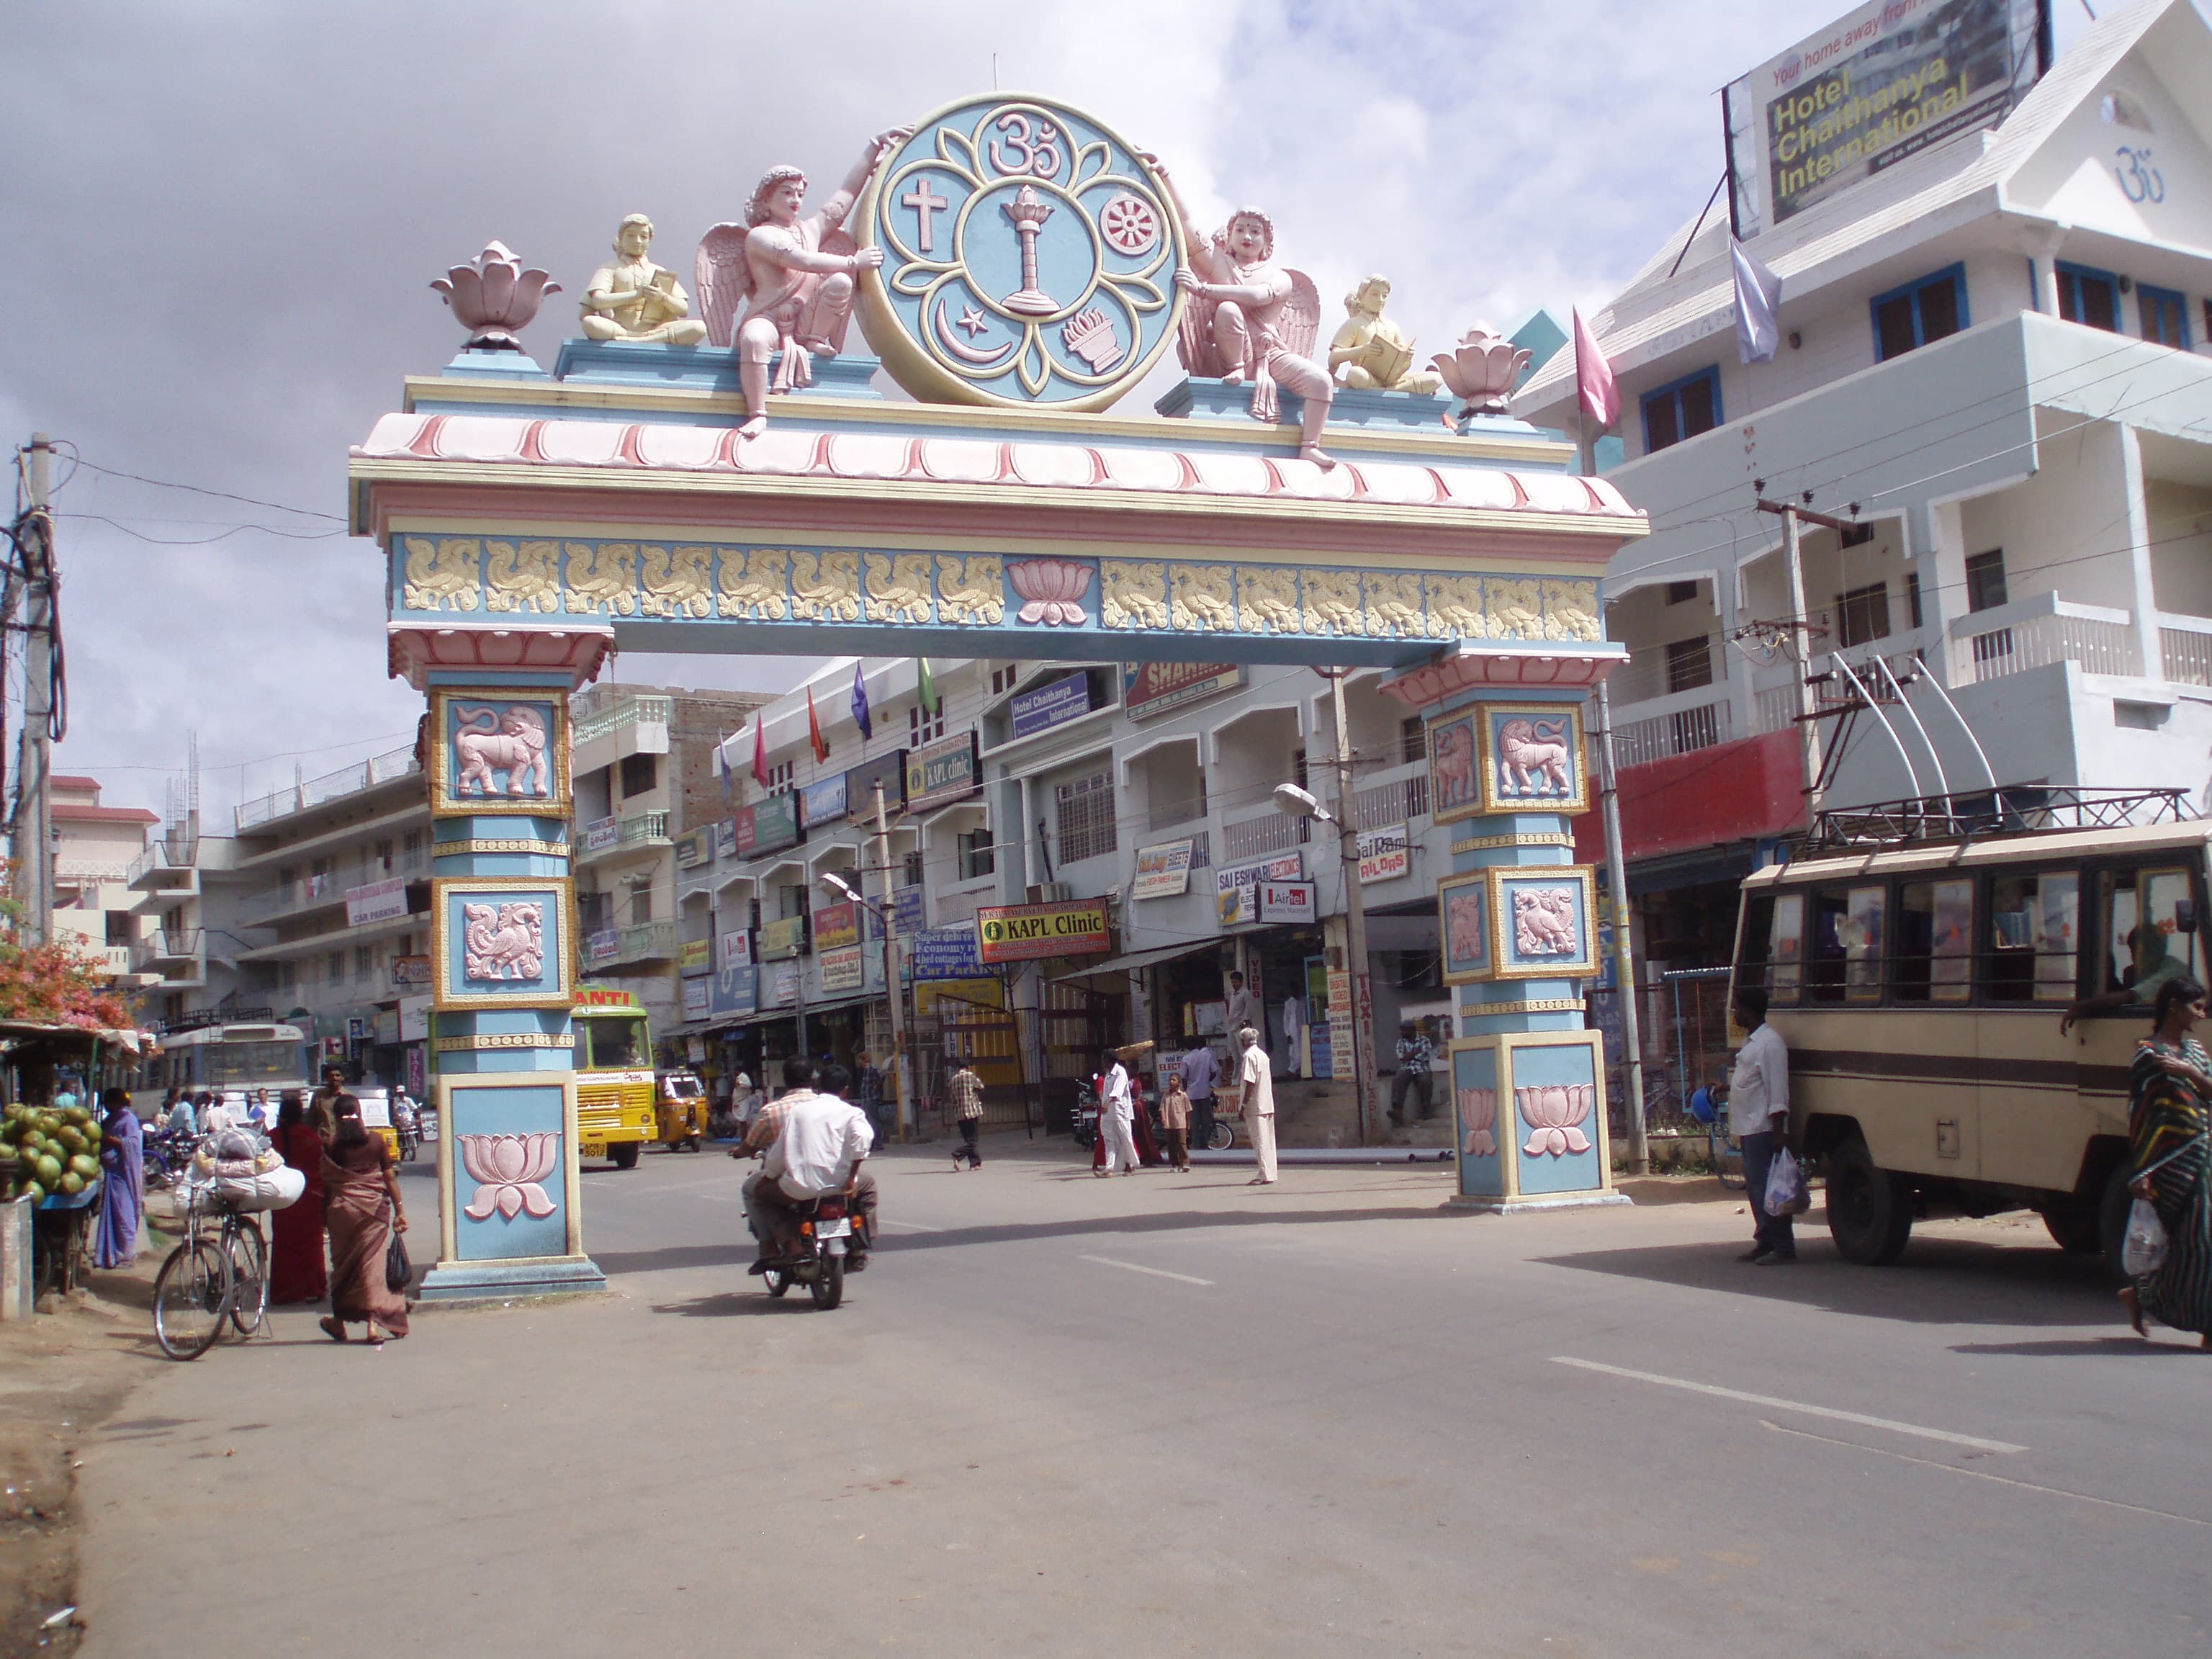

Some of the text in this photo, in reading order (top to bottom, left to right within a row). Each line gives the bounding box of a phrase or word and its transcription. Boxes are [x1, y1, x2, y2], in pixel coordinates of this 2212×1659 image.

[1773, 56, 1801, 87] Your
[1804, 37, 1840, 69] home
[1845, 15, 1879, 47] away
[1775, 68, 1851, 132] Hotel
[1778, 58, 1946, 163] Chaithanya
[1780, 73, 1968, 197] International
[1014, 685, 1071, 714] Hotel Chaithanya
[1049, 698, 1087, 722] International
[927, 755, 968, 786] KAPL clinic
[1374, 836, 1405, 855] Ram
[1219, 858, 1300, 890] SAI ESHWARI ELECTRONICS
[1360, 854, 1405, 878] AILORS
[1274, 893, 1303, 904] Airtel
[354, 906, 401, 922] CAR PARKING
[979, 909, 1008, 920] KERALA
[1007, 912, 1102, 939] KAPL Clinic
[914, 930, 972, 943] Super deluxe
[915, 943, 966, 954] Economy
[916, 964, 1001, 976] Car Parking
[921, 954, 934, 963] bed
[935, 953, 963, 963] cottages
[1251, 960, 1261, 998] VIDEO
[1331, 979, 1347, 990] DIGITAL
[1334, 991, 1347, 1000] VIDEO
[1357, 974, 1371, 1036] TAXI
